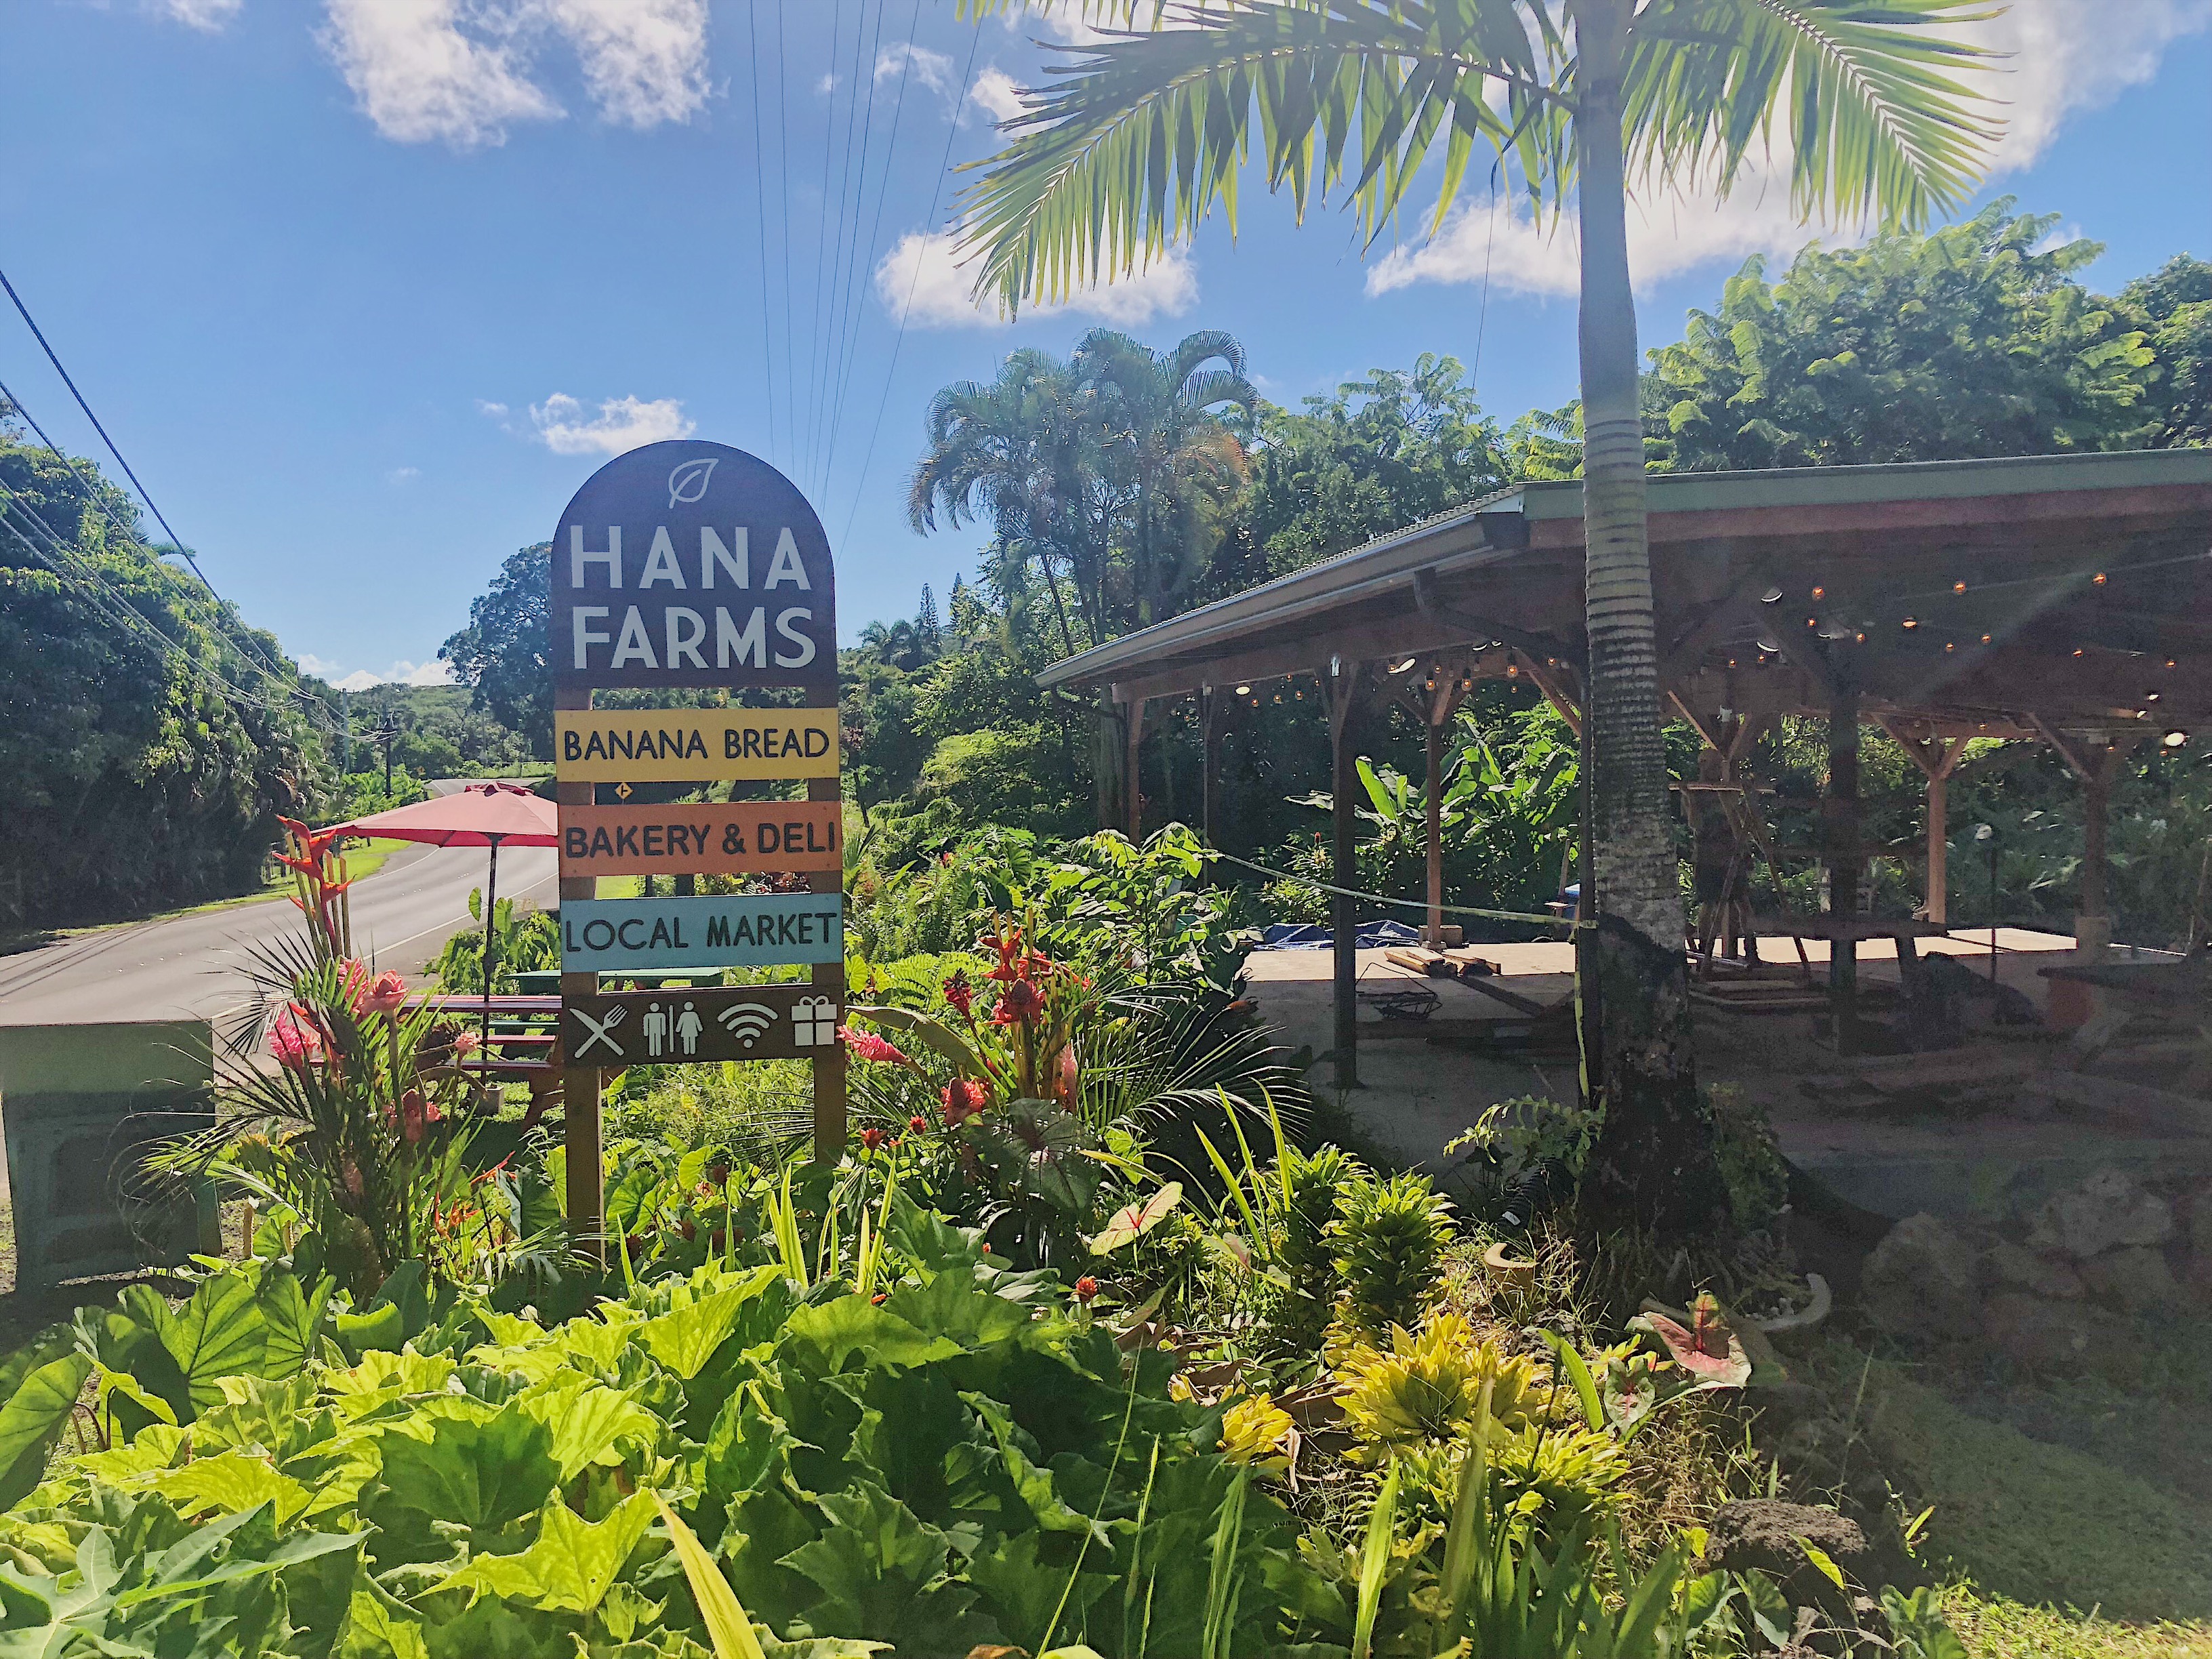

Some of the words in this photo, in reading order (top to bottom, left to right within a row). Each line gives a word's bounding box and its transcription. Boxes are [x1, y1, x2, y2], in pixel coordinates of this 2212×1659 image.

[570, 525, 812, 590] HANA
[573, 605, 817, 670] FARMS
[564, 729, 708, 761] BANANA
[724, 728, 830, 758] BREAD
[566, 823, 711, 858] BAKERY
[722, 823, 746, 854] &
[758, 821, 836, 854] DELI
[566, 916, 689, 952] LOCAL
[707, 912, 837, 947] MARKET
